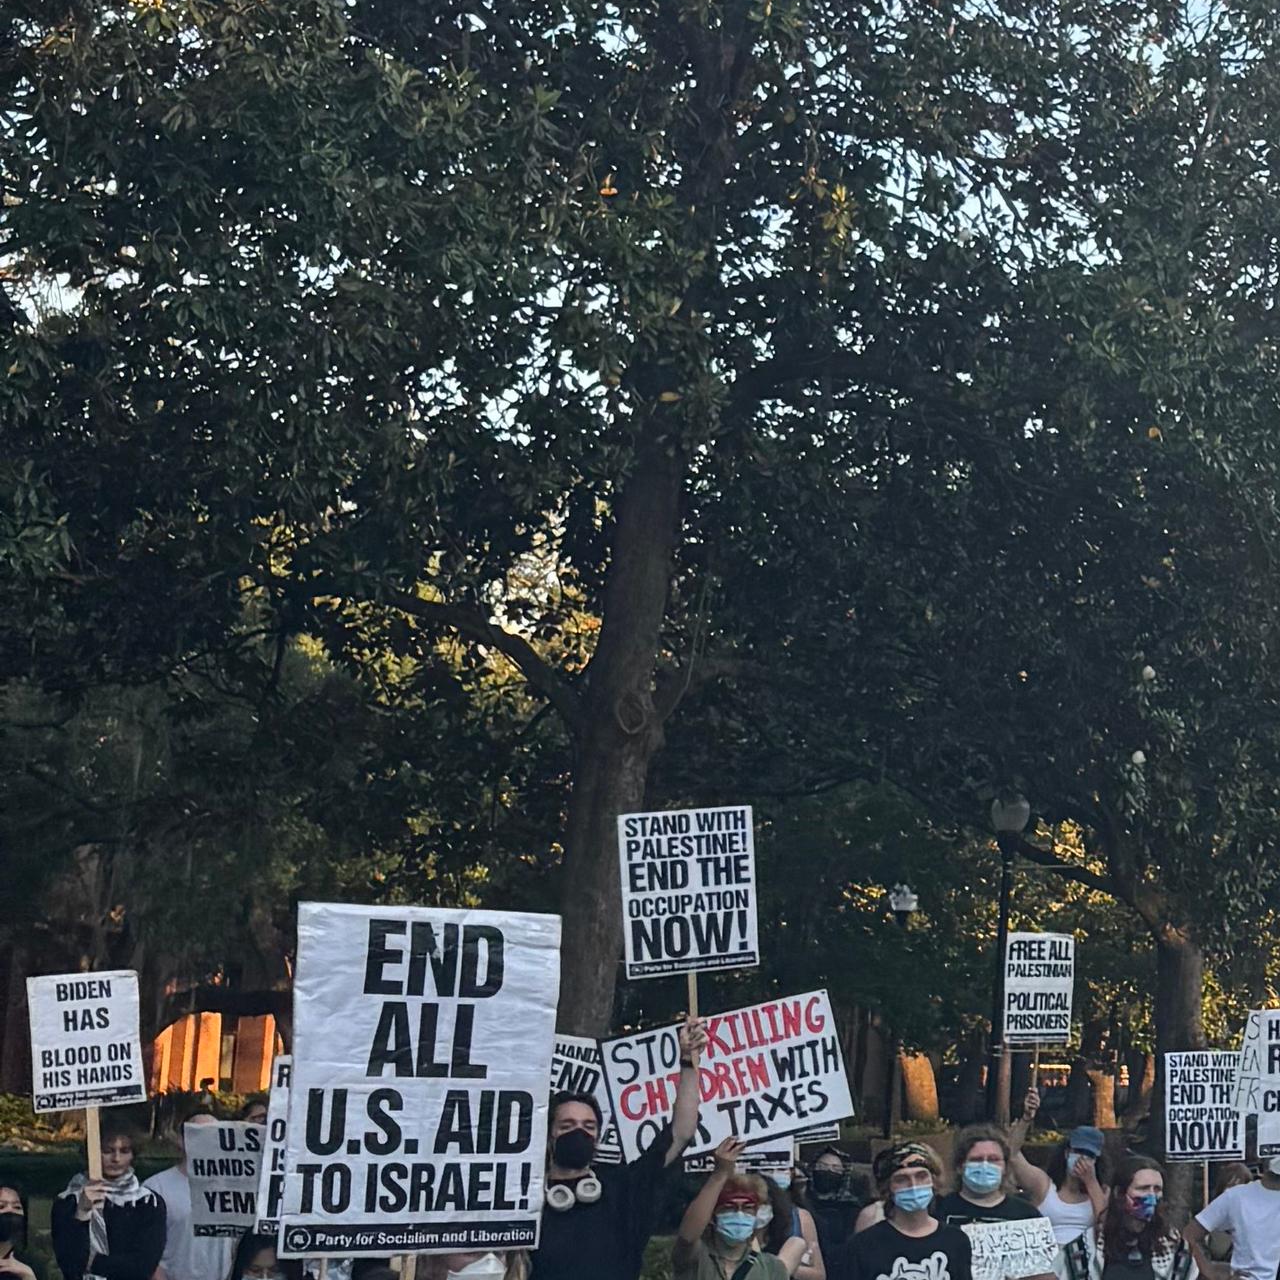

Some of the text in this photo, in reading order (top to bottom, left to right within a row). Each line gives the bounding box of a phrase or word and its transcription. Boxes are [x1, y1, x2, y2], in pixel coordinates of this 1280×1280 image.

[625, 810, 746, 838] STAND WITH
[627, 832, 747, 861] PALESTINE!
[629, 855, 751, 892] END THE
[628, 889, 749, 918] OCCUPATION
[631, 910, 748, 961] NOW!
[363, 919, 504, 998] END
[1009, 941, 1071, 960] FREE ALL
[56, 980, 112, 1002] BIDEN
[1008, 992, 1069, 1011] POLITICAL
[64, 1007, 109, 1032] HAS
[366, 1001, 488, 1079] ALL
[611, 997, 825, 1085] STO KILLING
[41, 1042, 131, 1068] BLOOD ON
[1170, 1054, 1239, 1067] STAND WITH
[43, 1064, 133, 1088] HIS HANDS
[620, 1036, 839, 1120] CHIDREN WITH
[717, 1081, 828, 1136] TAXES
[1170, 1085, 1234, 1105] END TH
[306, 1088, 534, 1155] U.S. AID
[1170, 1122, 1238, 1151] NOW!
[193, 1159, 255, 1177] HANDS
[297, 1162, 532, 1214] TO ISRAEL!
[204, 1191, 258, 1214] YEM
[316, 1229, 533, 1247] Party for Socialism and Liberation
